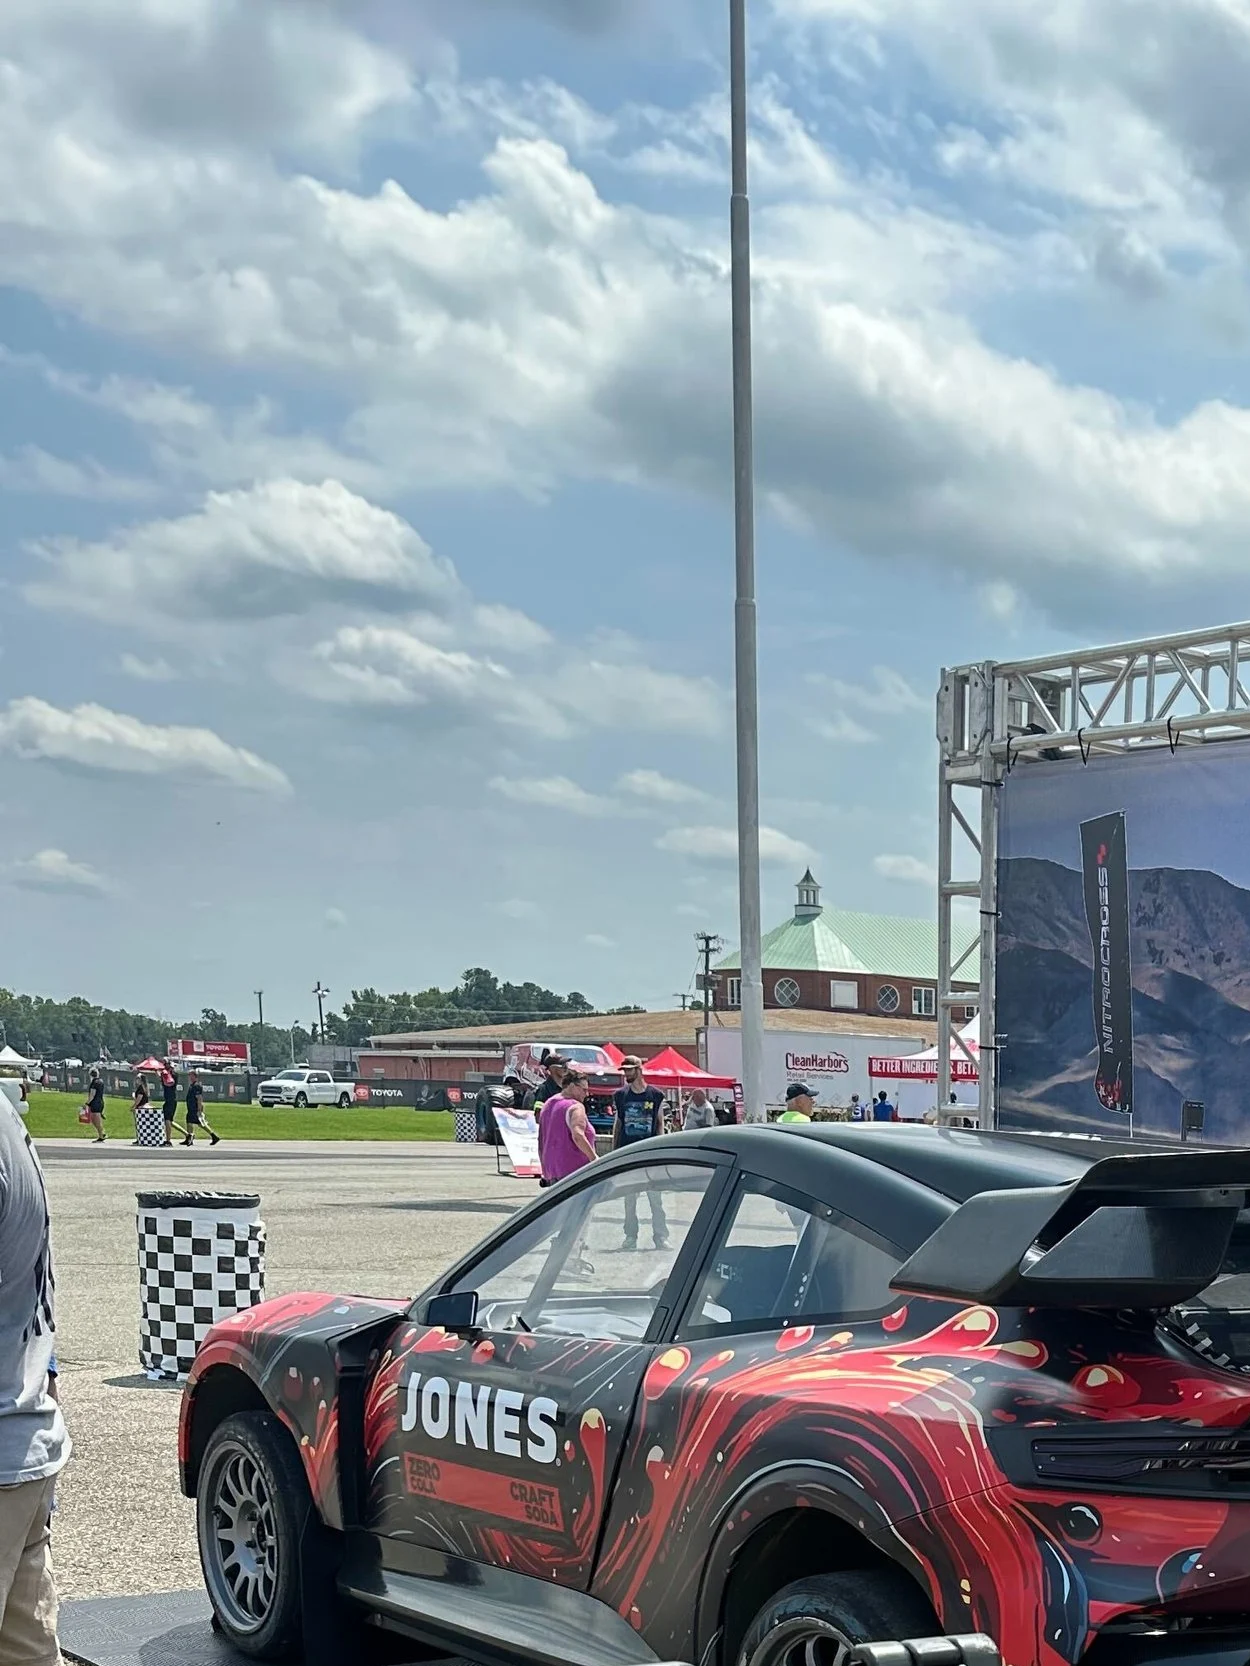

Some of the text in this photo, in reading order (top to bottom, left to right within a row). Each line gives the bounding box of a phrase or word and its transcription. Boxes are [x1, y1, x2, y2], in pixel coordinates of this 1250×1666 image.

[1097, 866, 1114, 1055] NITROCROSS
[205, 1044, 230, 1052] TOYOTA
[872, 1059, 900, 1073] BETTER
[901, 1060, 955, 1075] INGREDIES.
[371, 1088, 403, 1097] TOYOTA
[463, 1091, 478, 1100] TOY
[401, 1372, 559, 1463] JONES
[408, 1457, 441, 1480] ZERO
[410, 1476, 436, 1495] COLA
[510, 1481, 555, 1506] CRAFT
[525, 1503, 558, 1528] SODA
